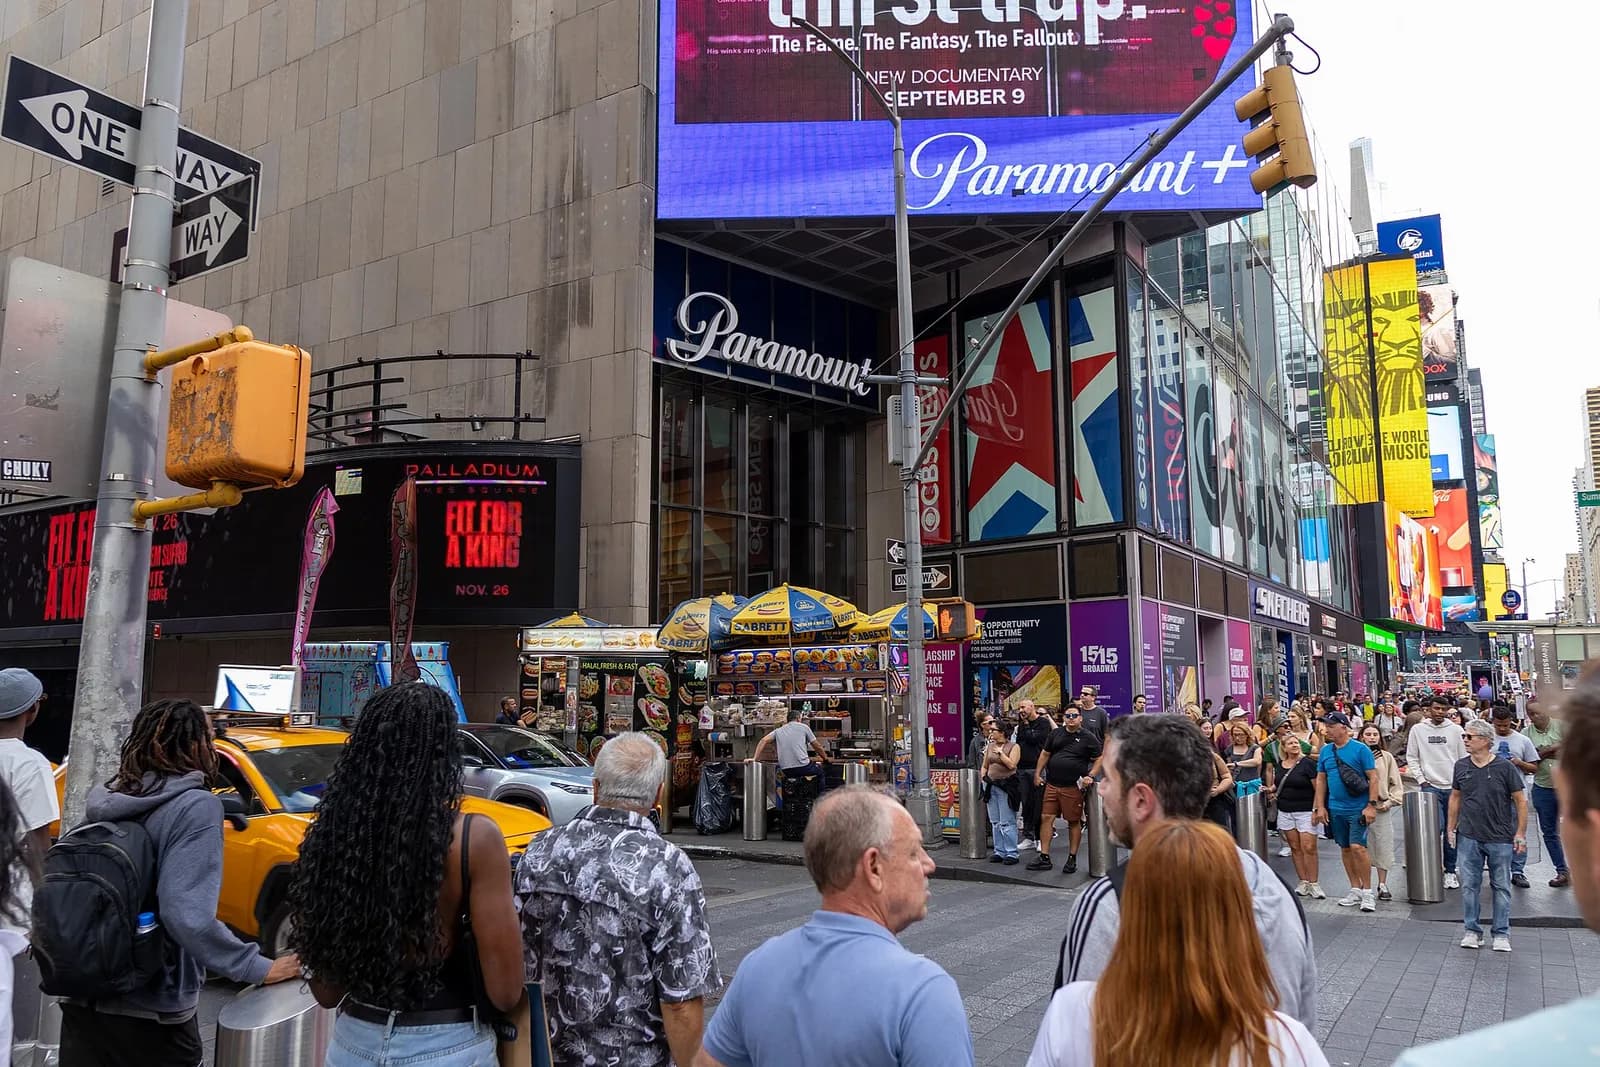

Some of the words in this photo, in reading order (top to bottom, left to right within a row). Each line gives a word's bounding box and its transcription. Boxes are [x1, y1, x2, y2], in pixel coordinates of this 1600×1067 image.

[768, 35, 801, 53] The
[863, 32, 897, 51] The
[900, 31, 971, 53] Fantasy.
[975, 29, 1009, 48] The
[1013, 28, 1079, 48] Fallout.
[866, 69, 905, 85] NEW
[911, 66, 1044, 85] DOCUMENTARY
[883, 89, 1007, 107] SEPTEMBER
[1011, 88, 1026, 105] 9
[50, 101, 128, 158] ONE
[186, 210, 228, 255] WAY
[666, 291, 872, 397] Paramount
[1426, 391, 1450, 402] UNG
[1391, 429, 1430, 445] WORLD
[1383, 442, 1428, 461] MUSIC
[3, 460, 50, 478] CHUKY
[406, 463, 541, 477] PALLADIUM
[920, 446, 940, 506] CBS
[163, 513, 178, 531] 26
[446, 500, 476, 537] FIT
[480, 500, 523, 537] FOR
[445, 536, 461, 568] A
[465, 535, 520, 568] KING
[896, 575, 907, 586] ON
[922, 572, 940, 584] WAY
[455, 585, 488, 597] NOV.
[492, 584, 510, 596] 26
[1256, 587, 1310, 627] SKECHERS
[734, 621, 788, 633] SABRETT
[986, 619, 1041, 630] OPPORTUNITY
[988, 628, 1022, 638] LIFETIME
[661, 636, 706, 649] SABRETT
[926, 649, 956, 661] AGSHIP
[925, 663, 944, 674] ETAIL
[1082, 664, 1118, 673] BROADWAY
[1275, 642, 1291, 721] SKECHER
[928, 703, 943, 714] ASE
